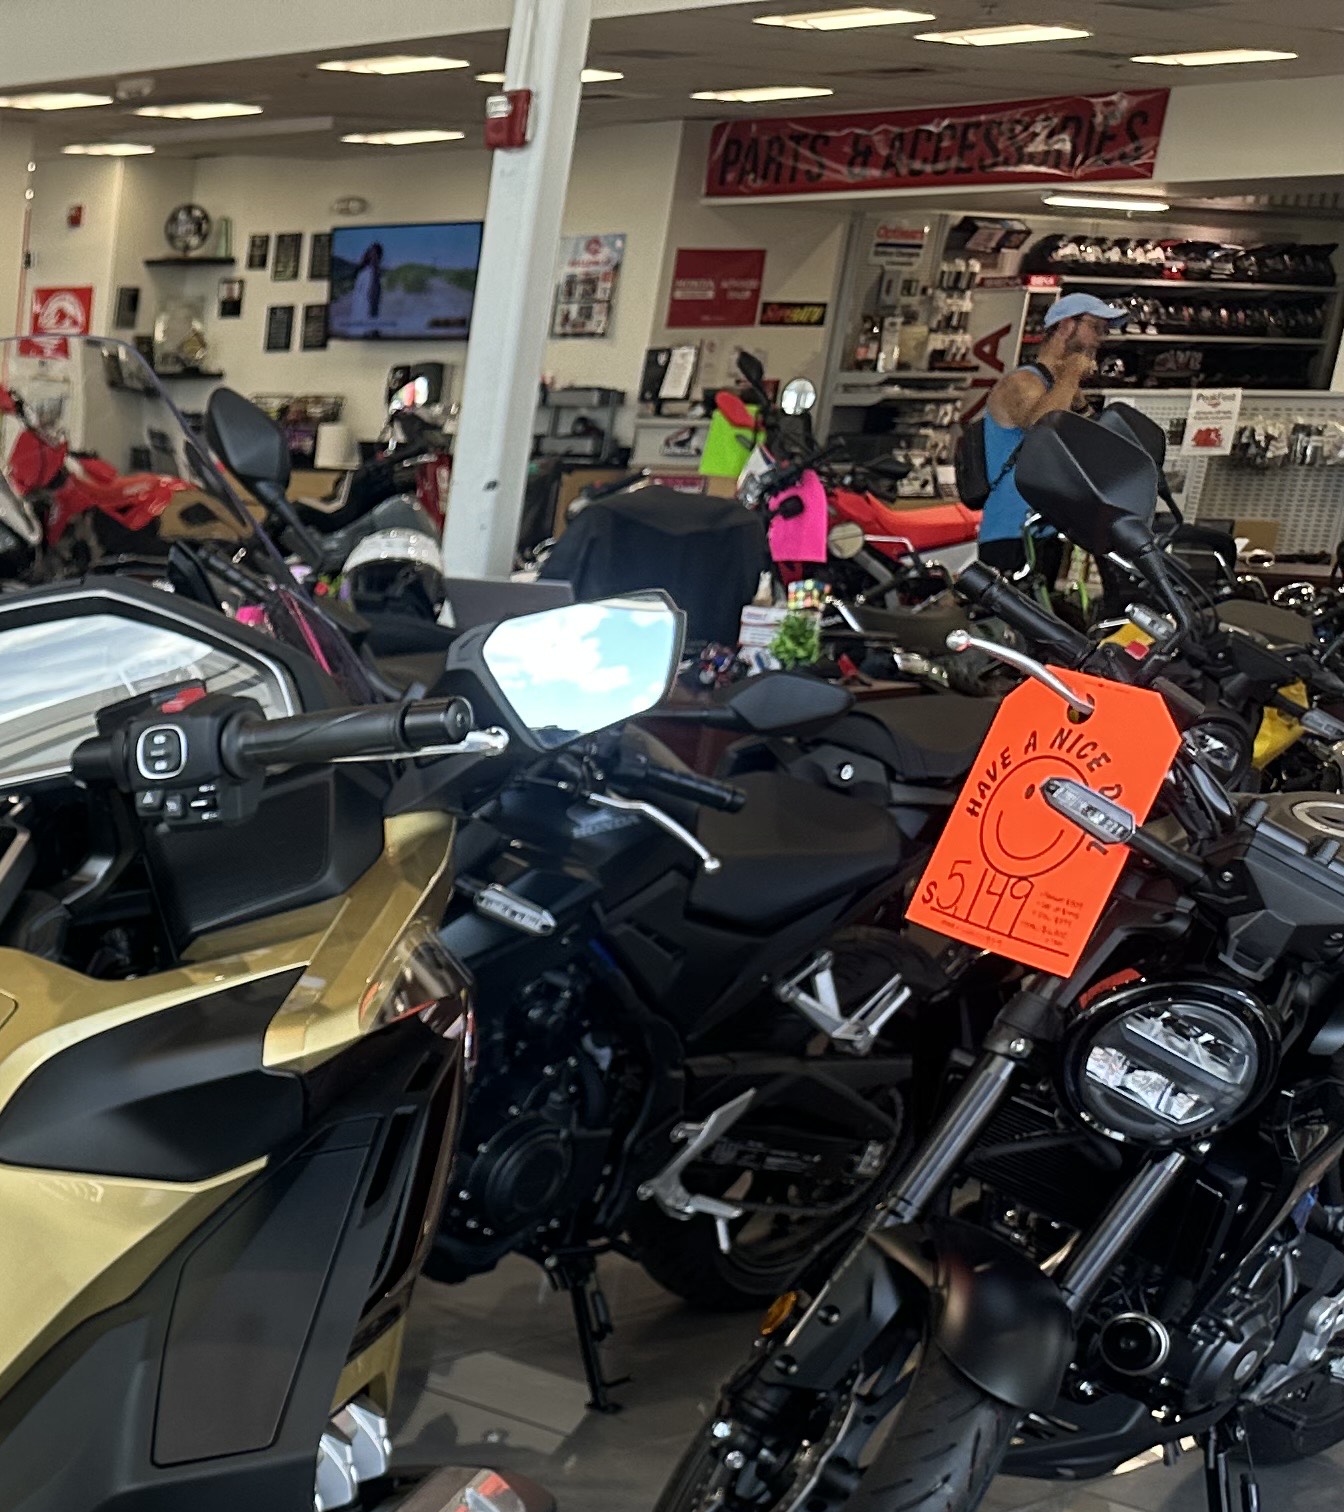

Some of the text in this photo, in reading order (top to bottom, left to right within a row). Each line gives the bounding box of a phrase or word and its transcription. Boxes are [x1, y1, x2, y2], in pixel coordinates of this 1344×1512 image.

[719, 131, 829, 187] PARTS
[846, 140, 872, 180] &
[965, 746, 1012, 818] HAVE
[1024, 731, 1038, 755] A
[1050, 727, 1111, 773] NICE
